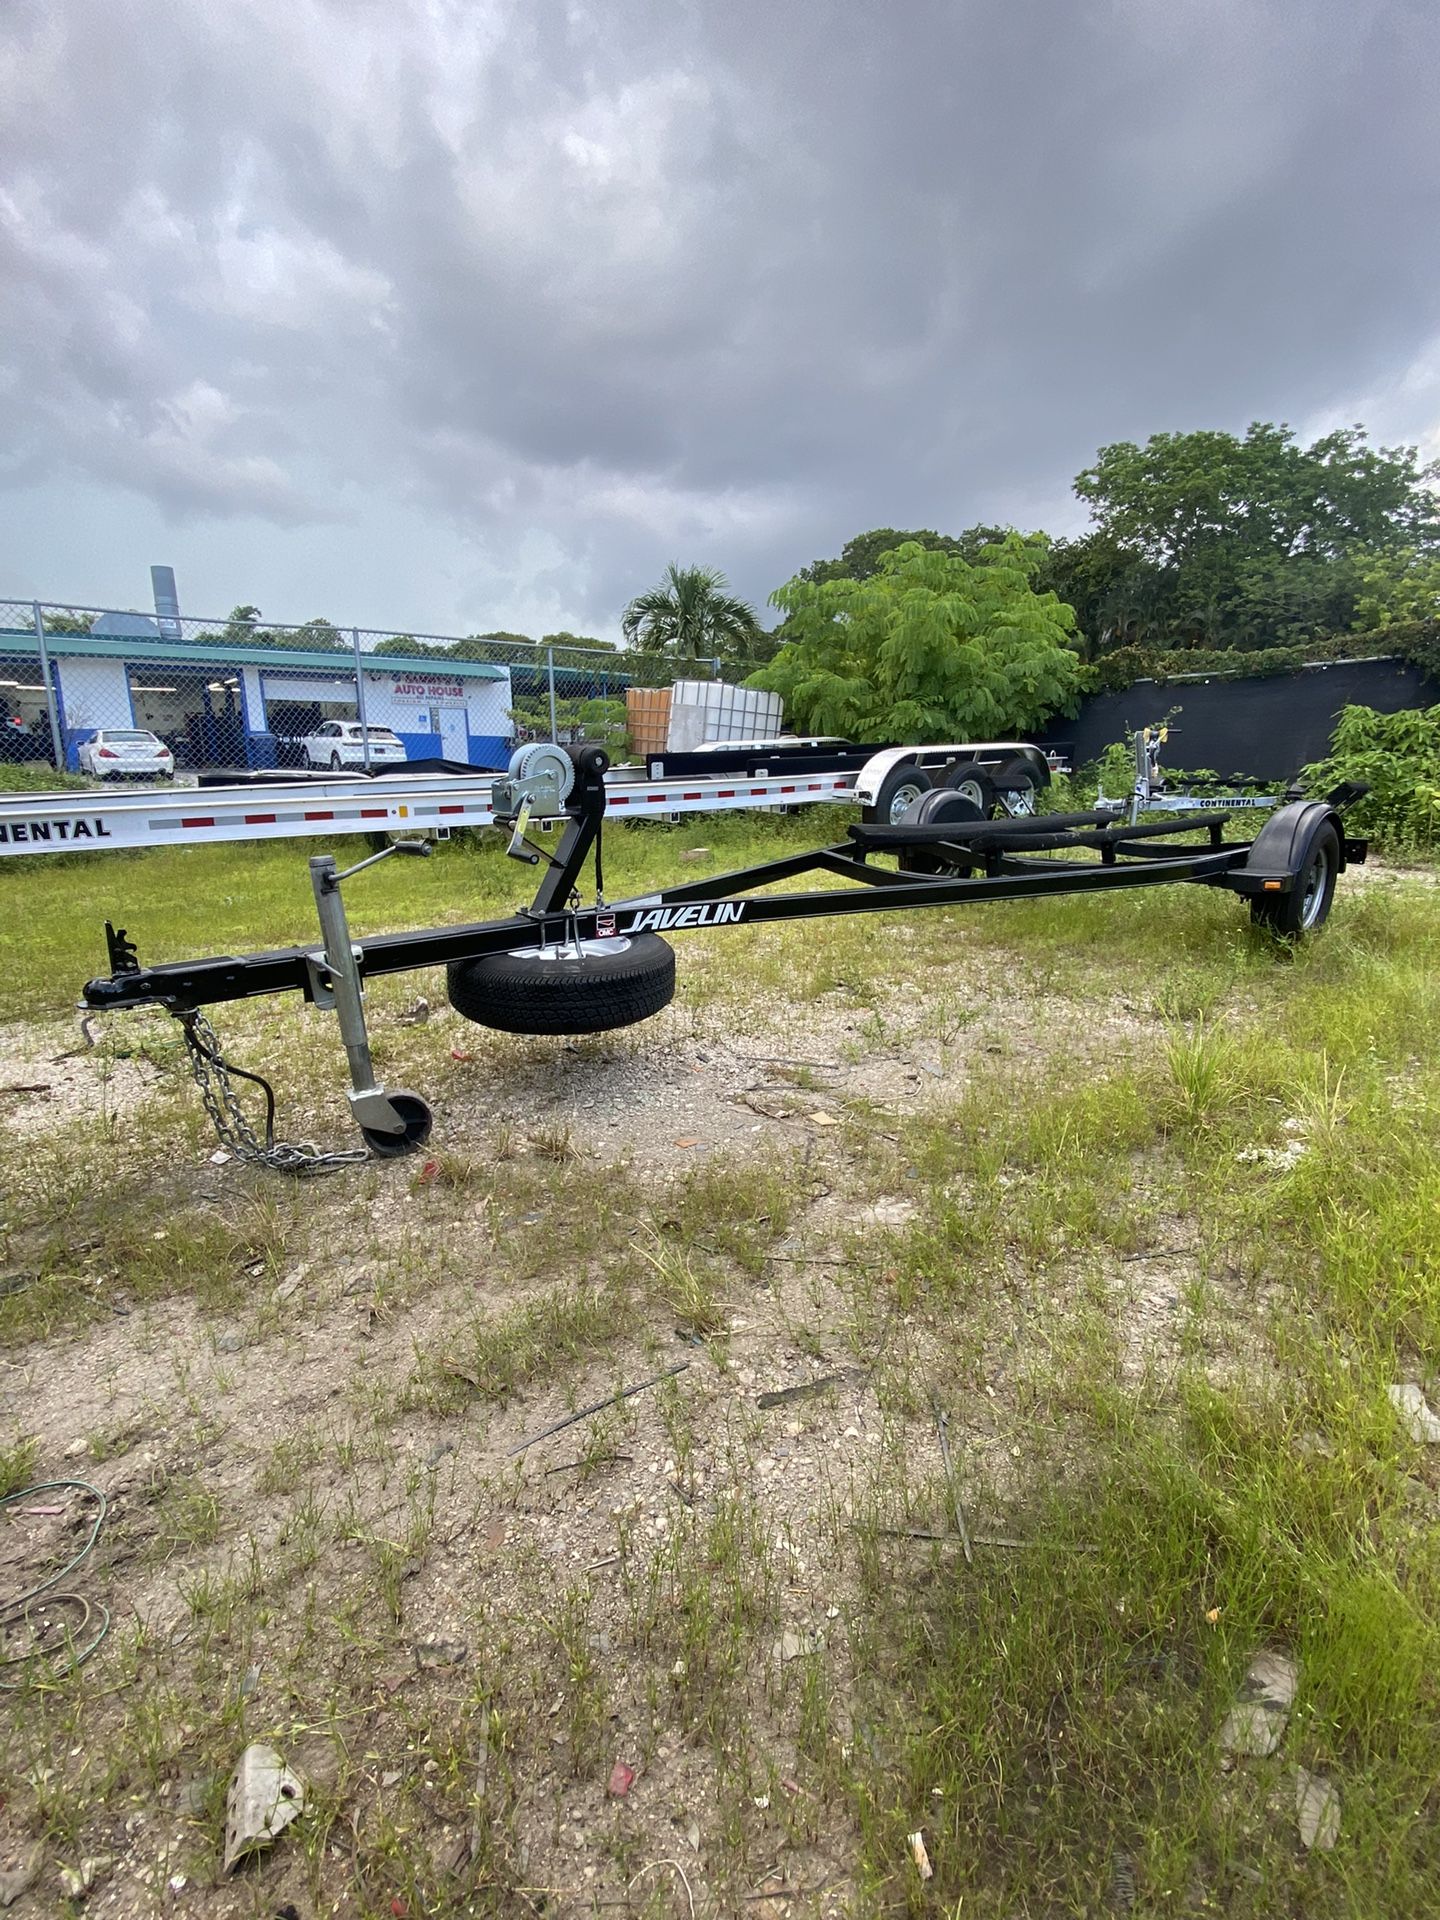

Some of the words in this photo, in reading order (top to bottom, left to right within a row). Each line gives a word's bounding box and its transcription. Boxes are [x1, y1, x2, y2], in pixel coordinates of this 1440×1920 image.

[394, 684, 425, 695] AUTO
[428, 686, 464, 697] HOUSE
[1200, 799, 1256, 808] CONTINENTAL
[619, 901, 746, 934] JAVELIN
[598, 928, 614, 936] OMC
